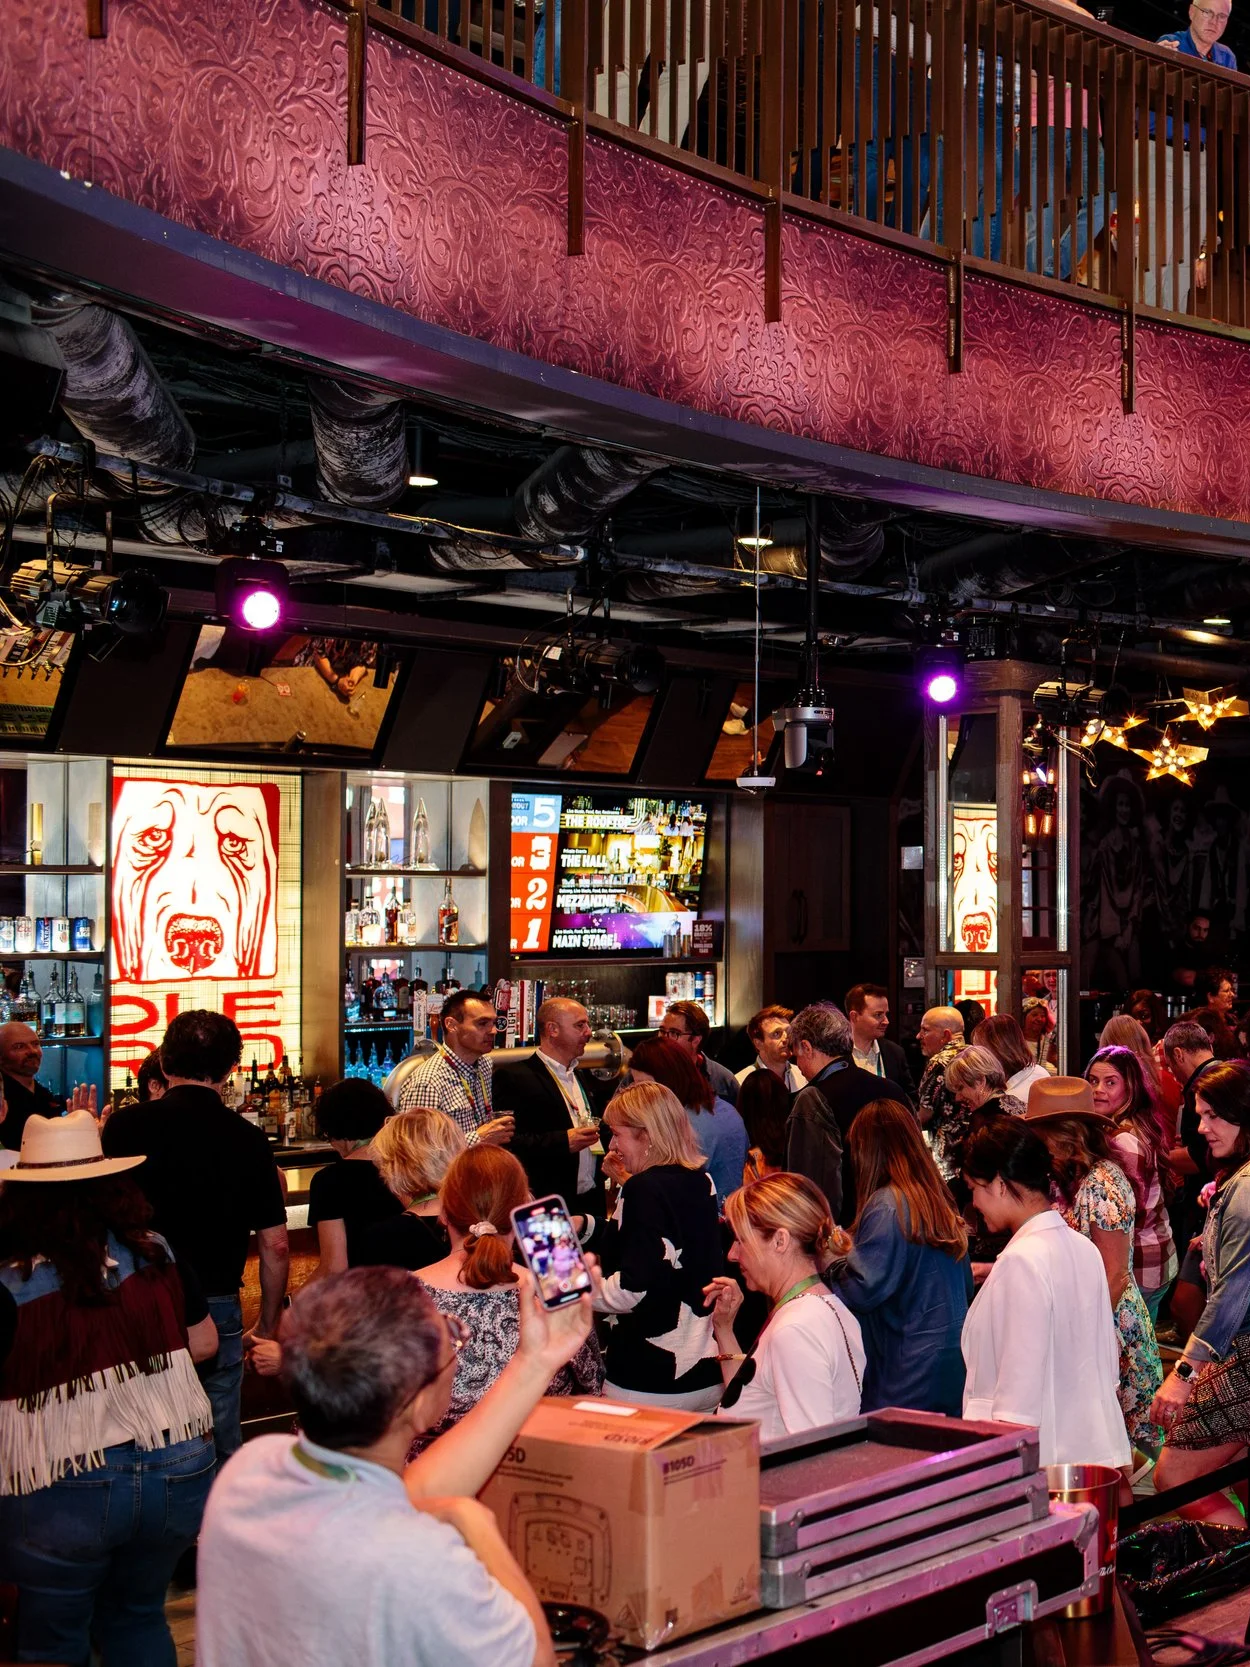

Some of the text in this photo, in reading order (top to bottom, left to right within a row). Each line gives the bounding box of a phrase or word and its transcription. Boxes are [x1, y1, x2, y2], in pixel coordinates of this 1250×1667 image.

[533, 797, 556, 828] 5
[564, 814, 584, 828] THE
[529, 835, 552, 870] 3
[560, 854, 608, 868] THE HALL
[525, 877, 548, 910] 2
[556, 894, 616, 908] MEZZANINE
[522, 918, 543, 949] 1
[552, 935, 581, 948] MAIN
[507, 1007, 516, 1035] LIGHT
